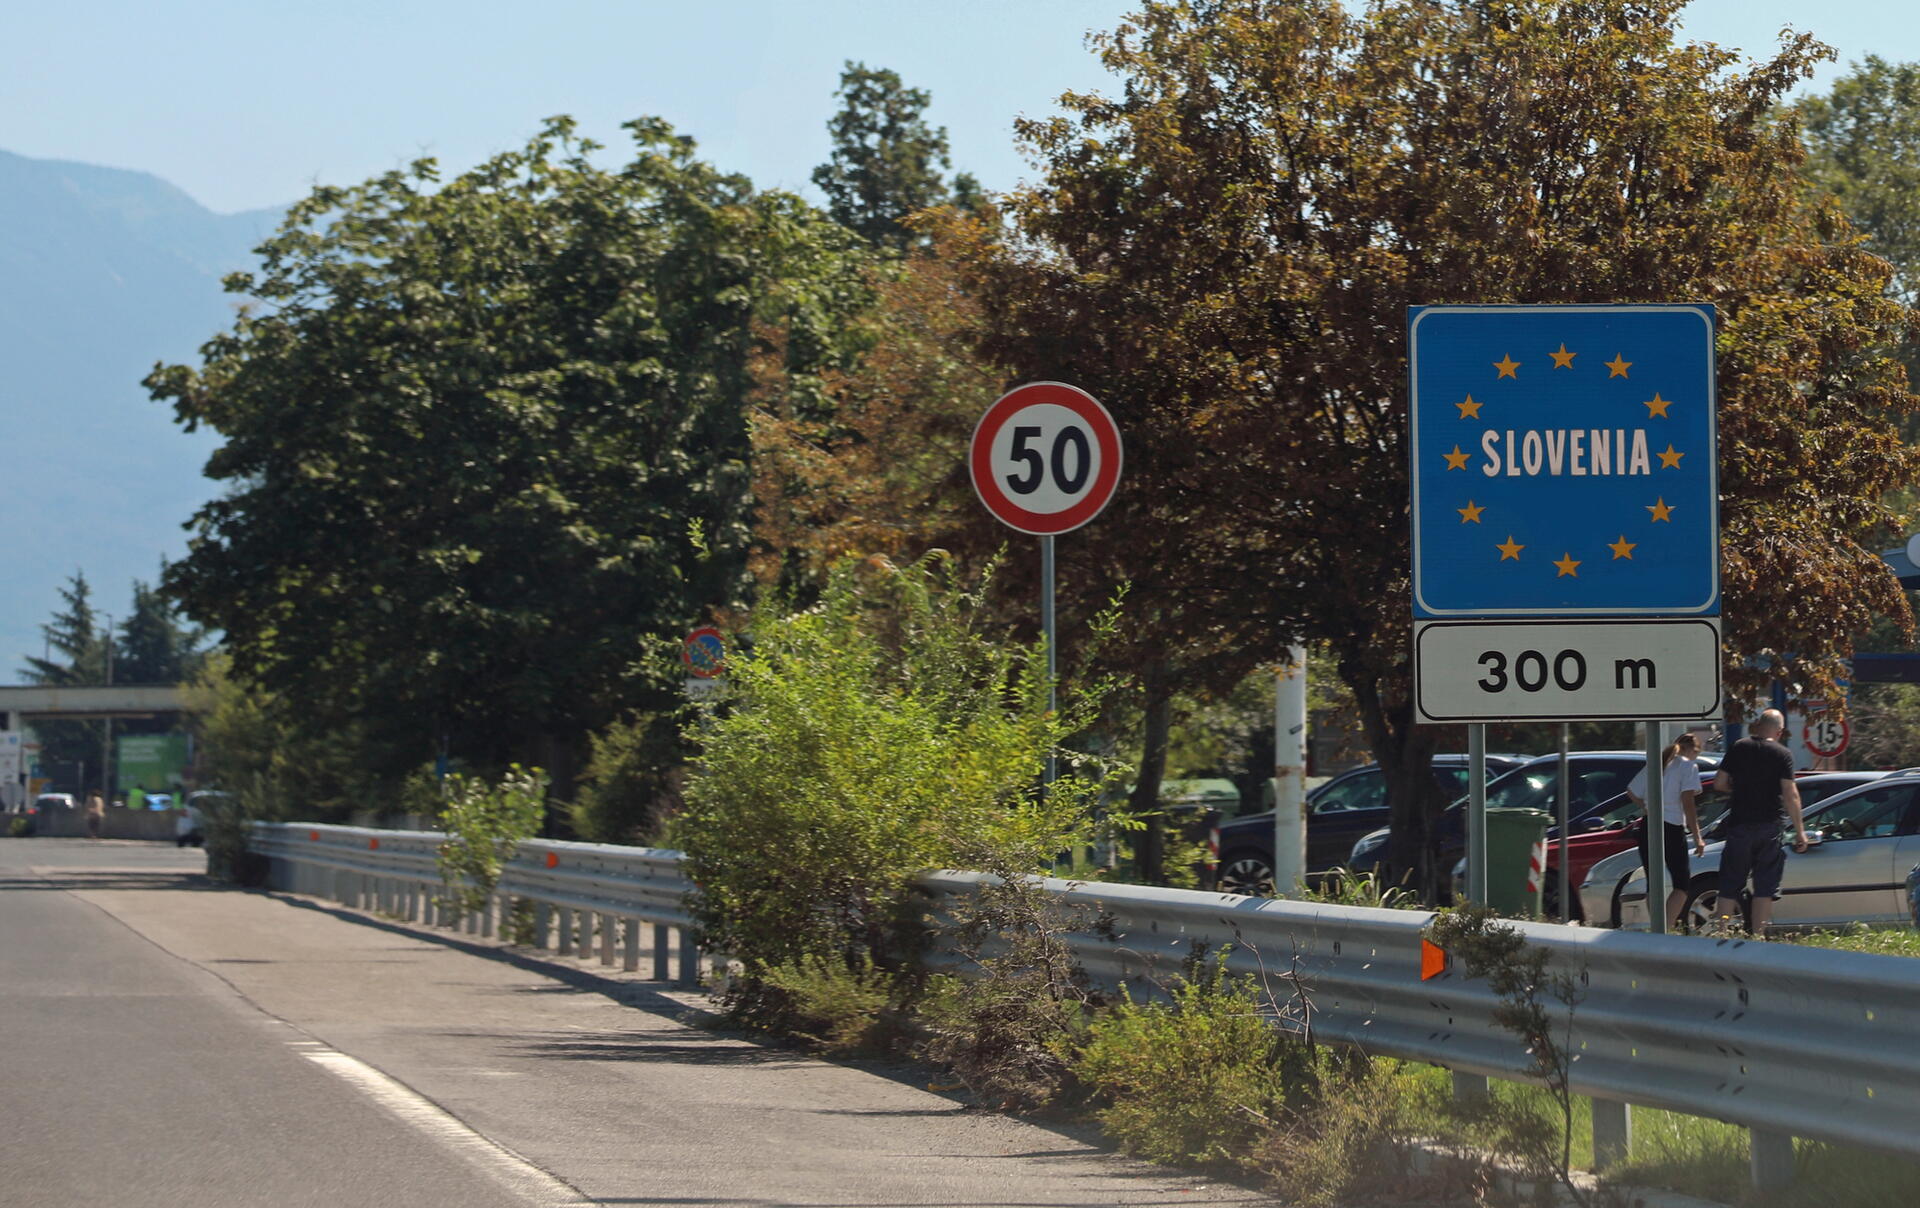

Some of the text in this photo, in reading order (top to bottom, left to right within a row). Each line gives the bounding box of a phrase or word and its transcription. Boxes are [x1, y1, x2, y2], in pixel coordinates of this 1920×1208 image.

[1006, 425, 1091, 495] 50
[1481, 429, 1651, 477] SLOVENIA
[1477, 649, 1657, 693] 300 m
[1816, 722, 1837, 744] 15
